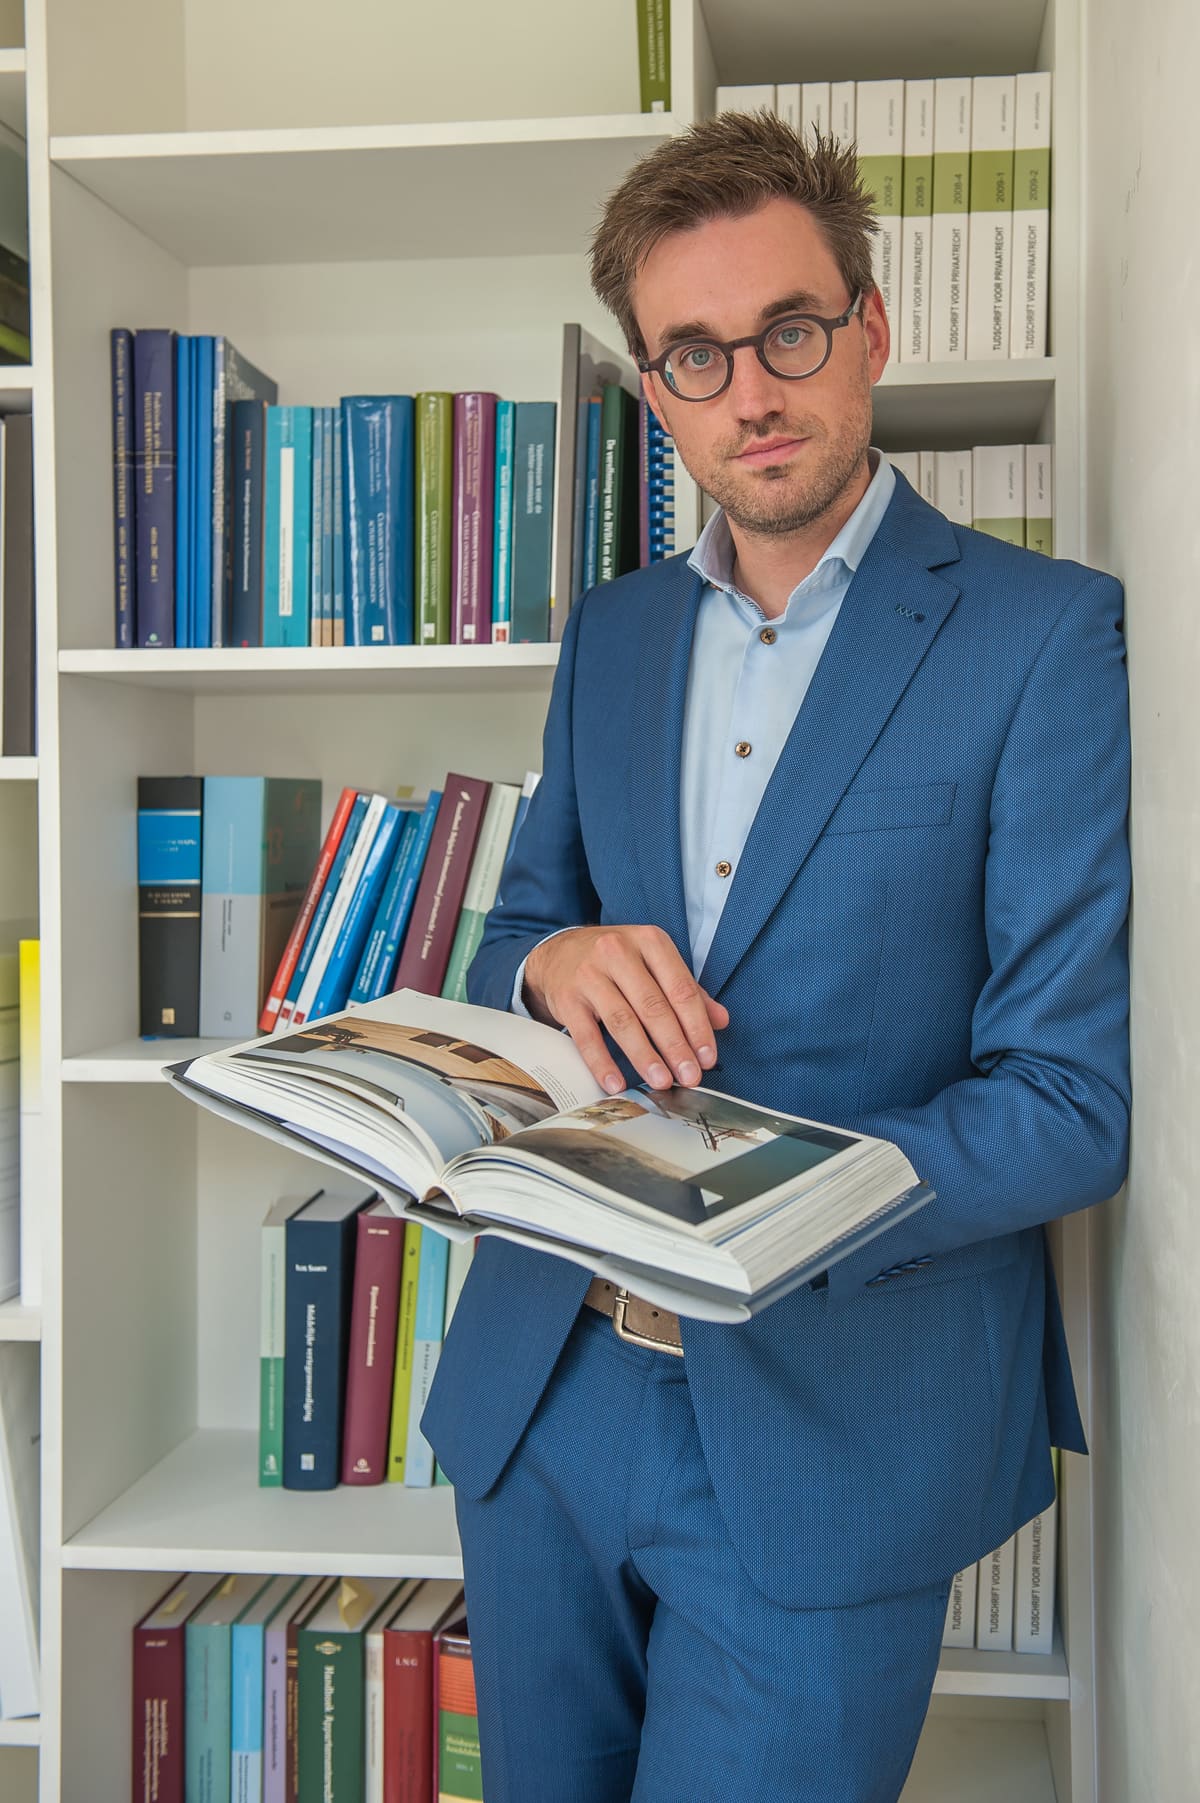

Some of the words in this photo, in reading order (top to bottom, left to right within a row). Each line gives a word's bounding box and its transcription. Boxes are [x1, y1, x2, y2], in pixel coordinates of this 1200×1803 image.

[884, 176, 893, 207] 2008-2
[914, 176, 925, 208] 2008-3
[953, 173, 963, 205] 2008-4
[995, 172, 1005, 203] 2009-1
[1028, 170, 1039, 201] 2009-2
[883, 231, 892, 286] PRIVAATRECHT
[914, 231, 923, 286] PRIVAATRECHT
[951, 228, 961, 282] PRIVAATRECHT
[994, 226, 1004, 281] PRIVAATRECHT
[1027, 225, 1037, 280] PRIVAATRECHT
[883, 286, 892, 307] VOOR
[913, 286, 922, 307] VOOR
[951, 284, 960, 305] VOOR
[994, 282, 1003, 304] VOOR
[1026, 281, 1036, 302] VOOR
[912, 309, 922, 355] TIJDSCHRIFT
[950, 306, 960, 352] TIJDSCHRIFT
[992, 305, 1003, 351] TIJDSCHRIFT
[1025, 304, 1036, 350] TIJDSCHRIFT
[606, 439, 616, 450] De
[603, 451, 615, 494] vereffening
[534, 504, 542, 514] de
[604, 495, 613, 509] van
[604, 510, 614, 521] de
[603, 521, 614, 544] BVBA
[603, 545, 611, 555] en
[603, 556, 612, 566] de
[602, 567, 612, 581] NV
[1032, 1515, 1042, 1565] PRIVAATREC
[991, 1564, 1000, 1585] VOOR
[1031, 1566, 1041, 1588] VOOR
[952, 1584, 963, 1631] TIJDSCHRIFT
[990, 1587, 1000, 1634] TIJDSCHRIFT
[1031, 1589, 1041, 1636] TIJDSCHRIFT
[323, 1664, 335, 1713] Handboek
